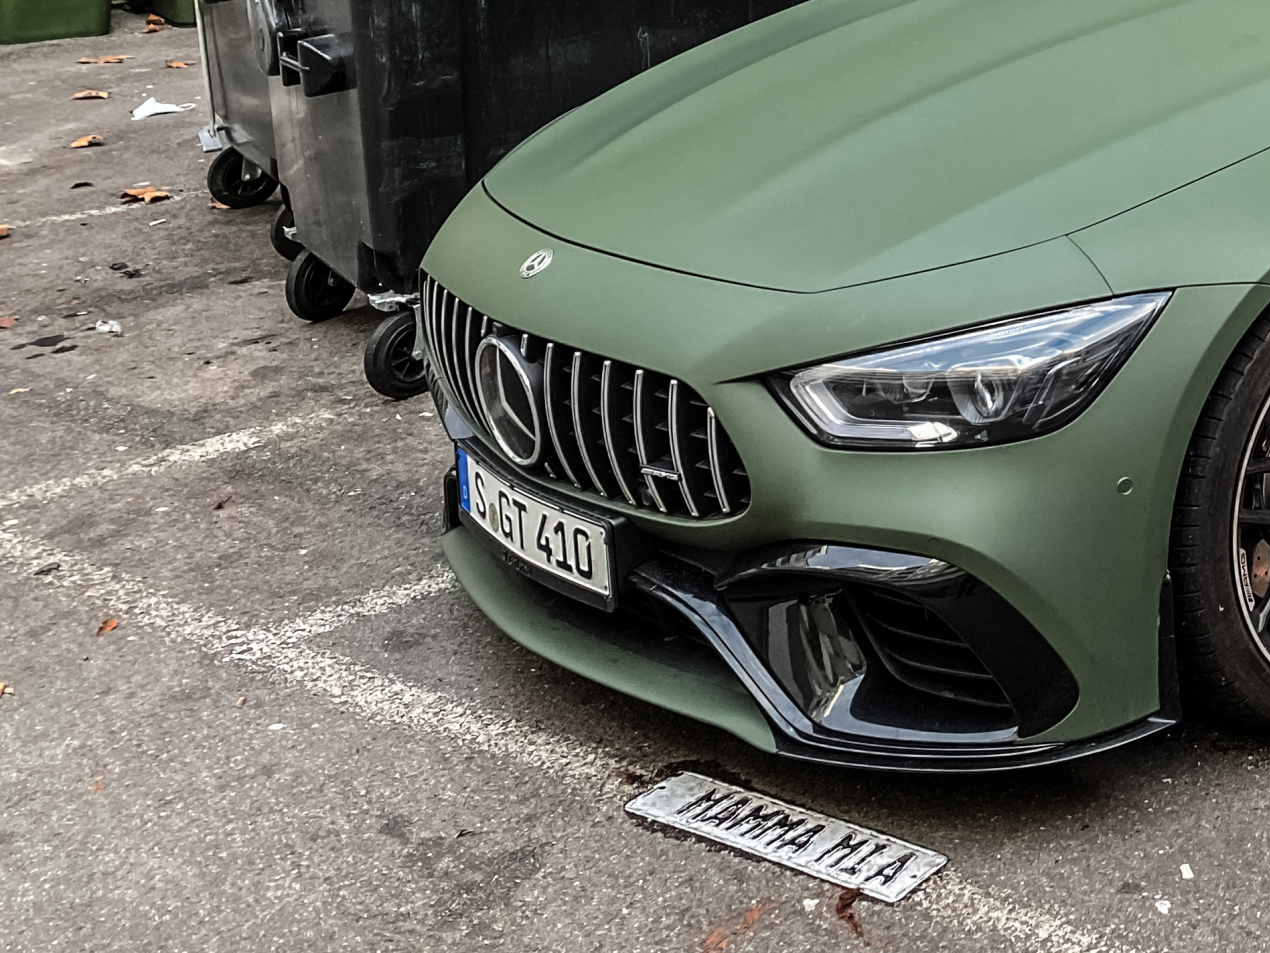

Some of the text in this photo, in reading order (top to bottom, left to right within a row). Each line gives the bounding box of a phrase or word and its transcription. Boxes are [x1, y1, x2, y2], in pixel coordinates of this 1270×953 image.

[475, 471, 487, 520] S
[498, 489, 527, 550] GT
[536, 513, 593, 580] 410
[677, 789, 917, 886] MAMMA MIA
